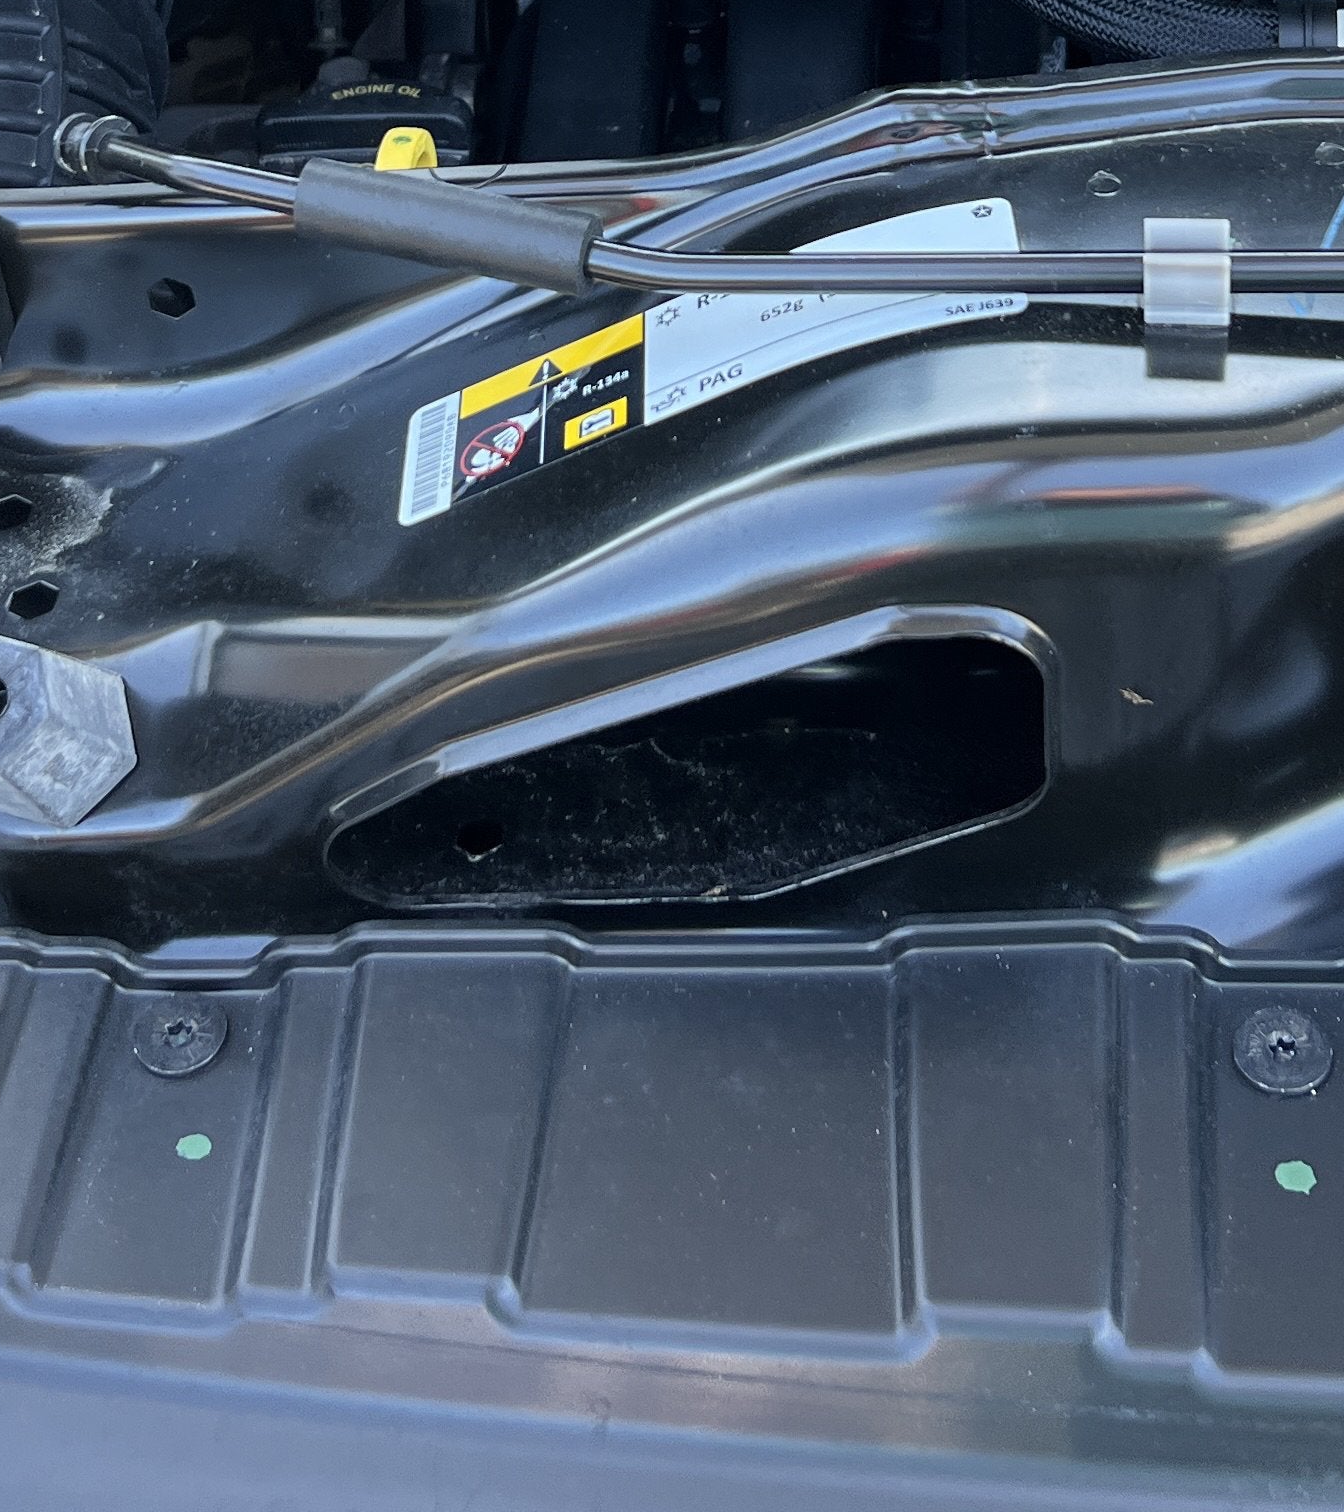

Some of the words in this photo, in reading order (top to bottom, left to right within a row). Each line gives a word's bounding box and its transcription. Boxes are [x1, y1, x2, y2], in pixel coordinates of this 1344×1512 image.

[331, 83, 395, 101] ENGINE
[397, 85, 422, 99] OIL
[945, 303, 975, 316] SAE
[978, 298, 1014, 311] J639
[582, 369, 630, 397] R-134a
[699, 363, 743, 392] PAG
